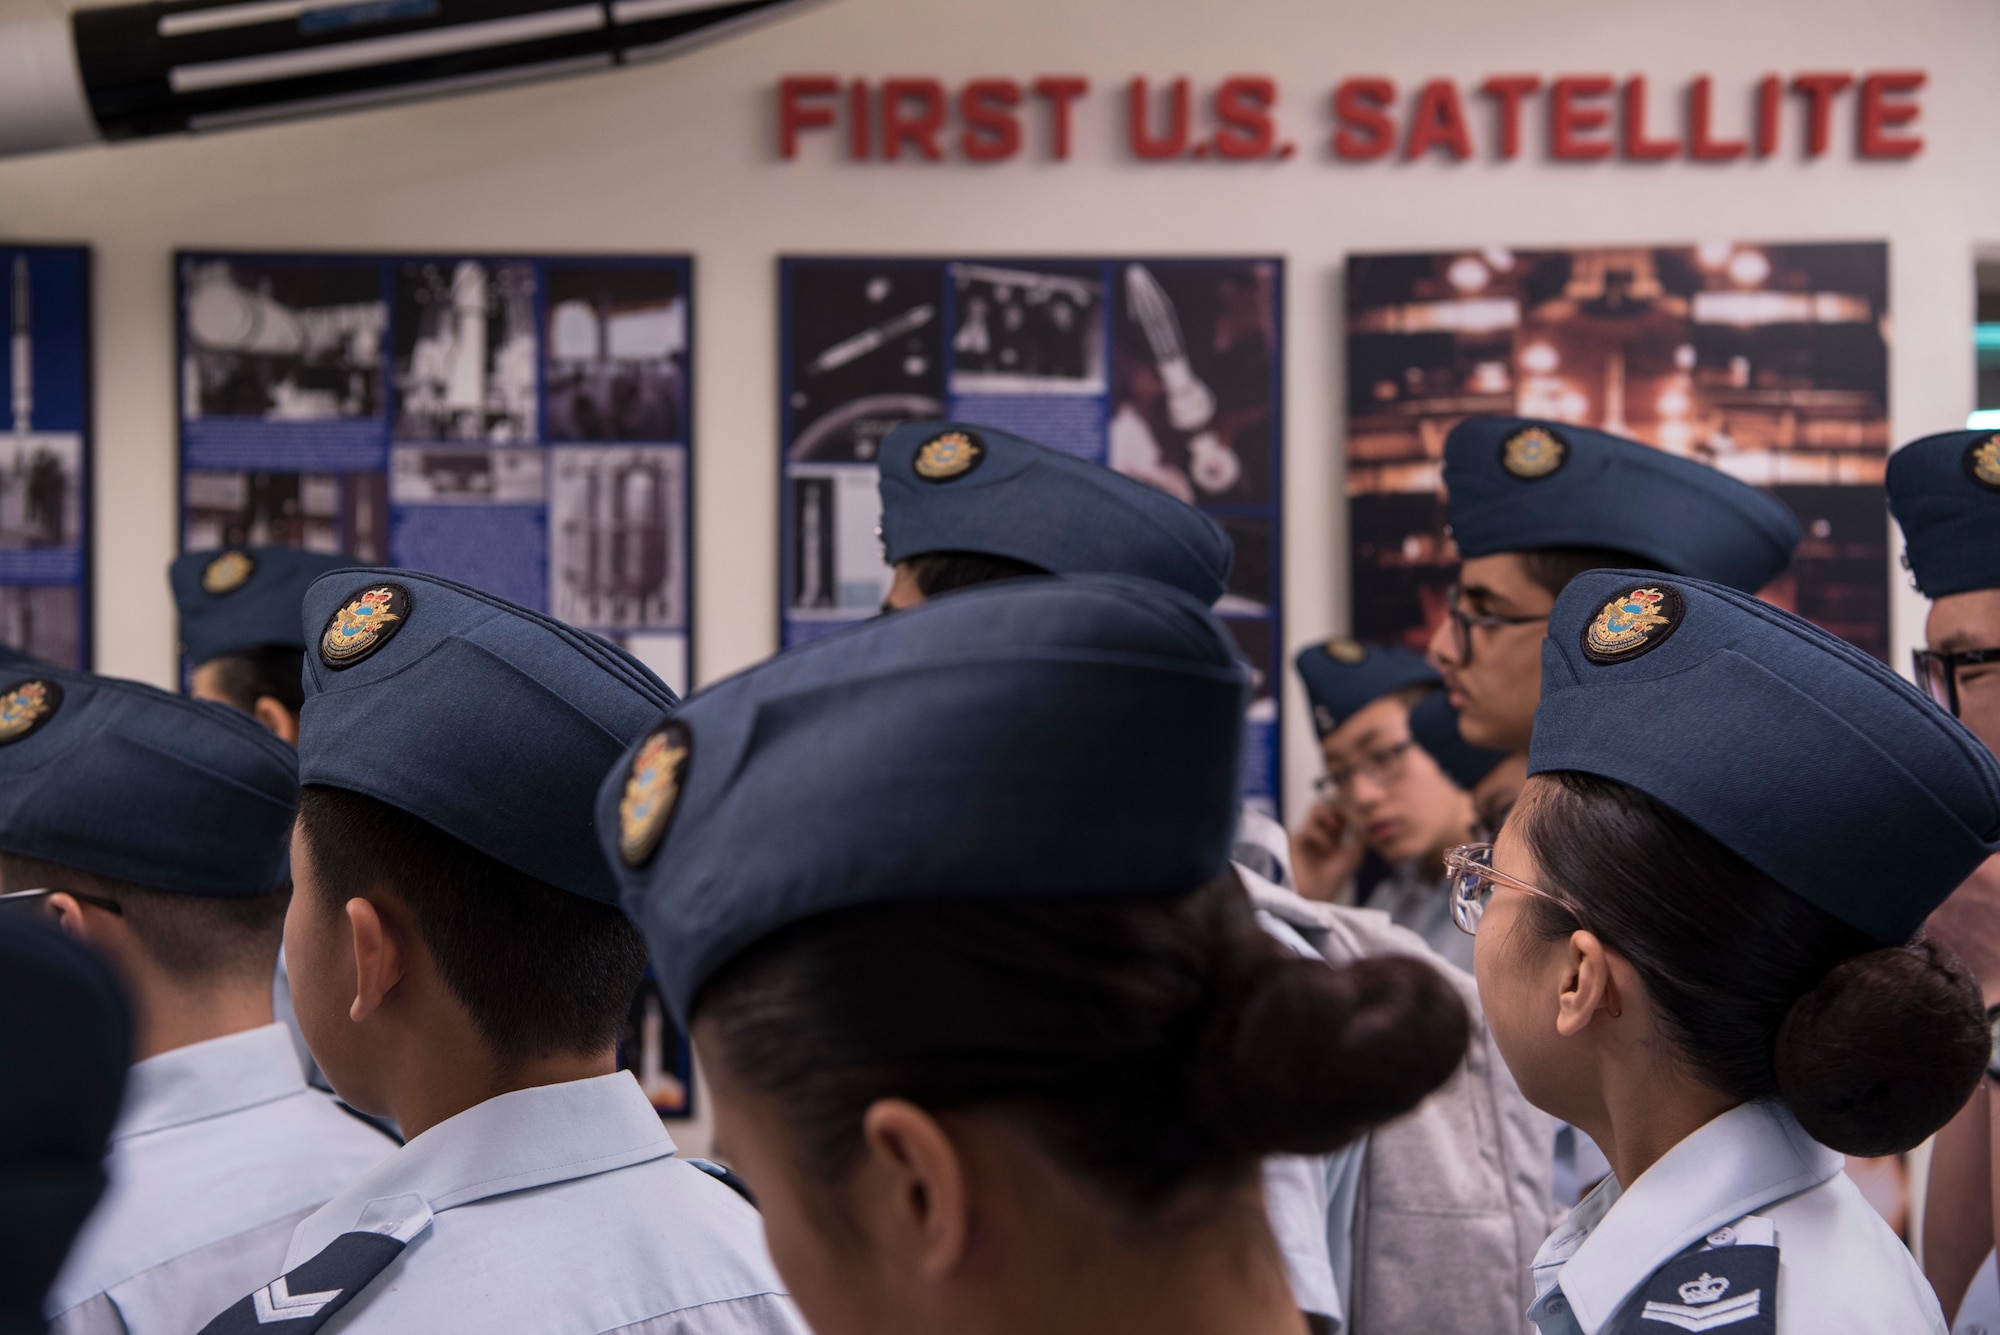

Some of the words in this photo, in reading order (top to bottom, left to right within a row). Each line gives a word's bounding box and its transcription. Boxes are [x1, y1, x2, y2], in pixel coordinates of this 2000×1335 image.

[778, 74, 1090, 161] FIRST
[1128, 74, 1297, 161] U.S.
[1331, 69, 1928, 161] SATELLITE
